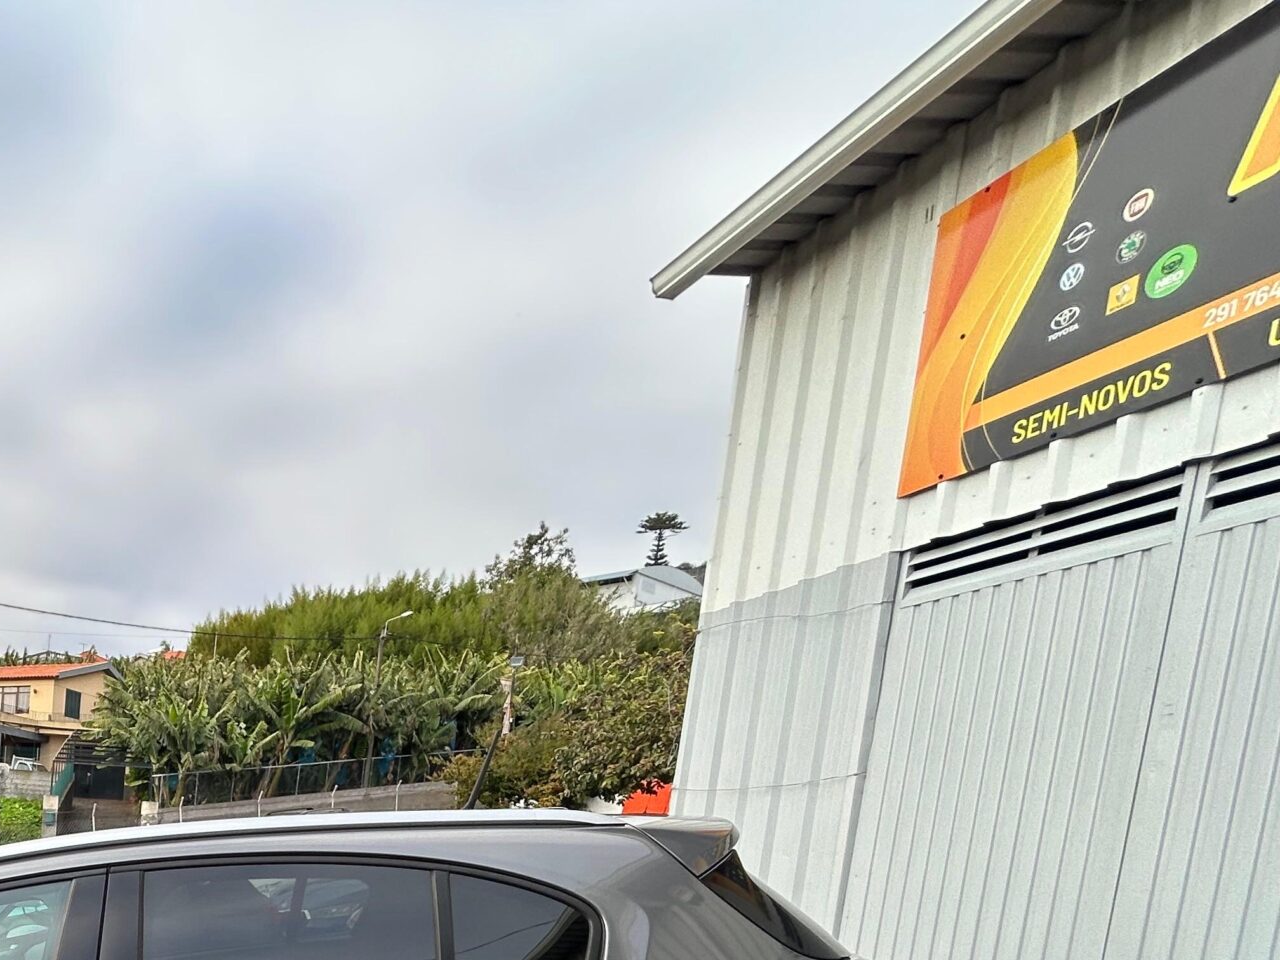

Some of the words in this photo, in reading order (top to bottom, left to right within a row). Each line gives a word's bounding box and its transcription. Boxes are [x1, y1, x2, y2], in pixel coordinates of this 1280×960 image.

[1203, 299, 1238, 328] 291
[1047, 323, 1079, 342] TOYOTA
[1011, 362, 1172, 444] SEMI-NOVOS
